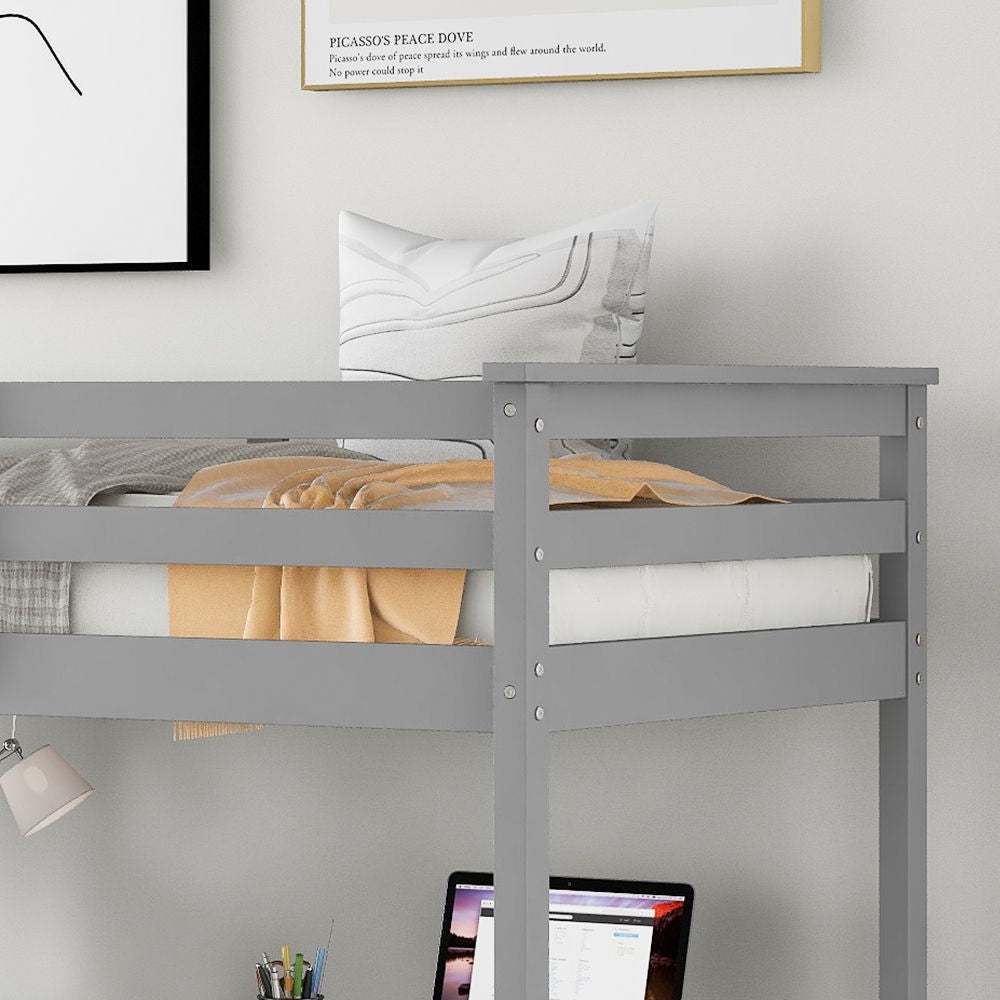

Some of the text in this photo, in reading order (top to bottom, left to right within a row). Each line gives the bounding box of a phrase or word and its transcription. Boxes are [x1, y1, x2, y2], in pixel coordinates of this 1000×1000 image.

[330, 32, 473, 48] PICASSO'S PEACE DOVE
[330, 43, 606, 63] Picasso's dove of peace spread its wings and flew around the world.
[329, 68, 342, 77] No
[345, 69, 369, 79] power
[372, 66, 394, 75] could
[398, 68, 415, 77] stop
